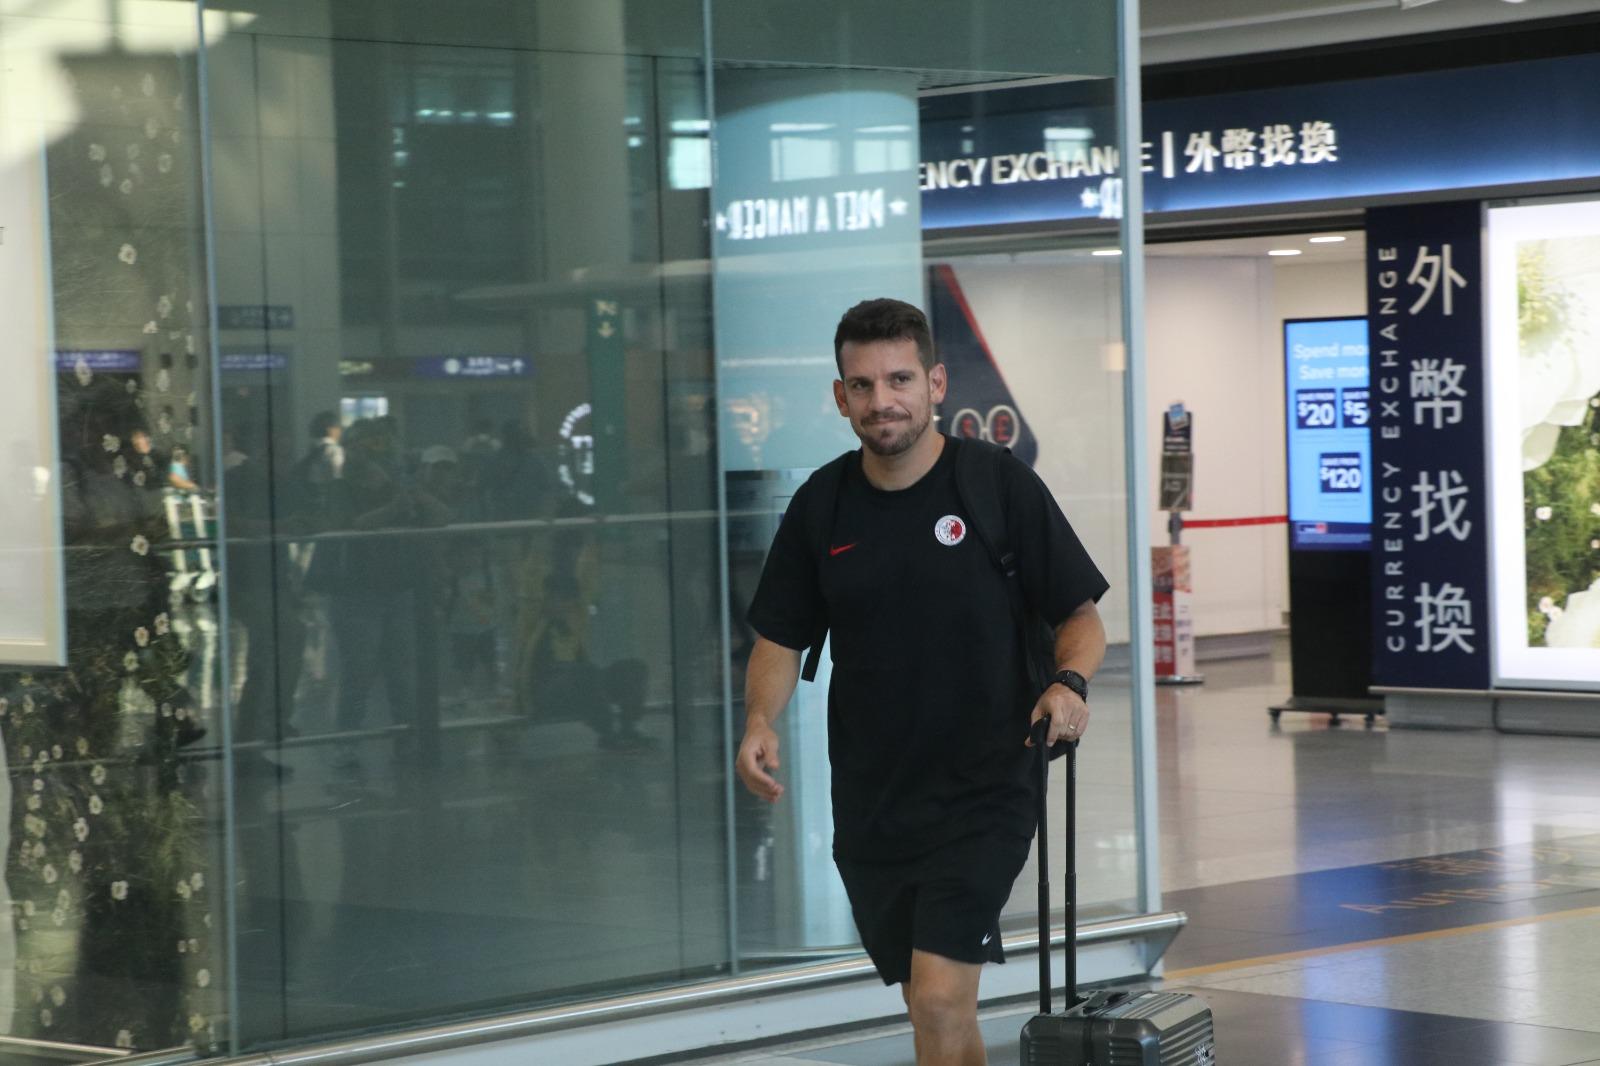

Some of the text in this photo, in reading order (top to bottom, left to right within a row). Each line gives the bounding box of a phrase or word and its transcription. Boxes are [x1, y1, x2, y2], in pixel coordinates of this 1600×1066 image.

[991, 140, 1155, 185] EXCHANE
[1184, 120, 1338, 173] 外幣找換
[1293, 341, 1340, 361] Spend
[1299, 365, 1335, 380] Save
[1298, 401, 1336, 425] $20
[1378, 247, 1405, 653] CURRENCY EXCHANGE
[1407, 244, 1475, 654] 外幣找換
[1320, 466, 1361, 489] $120
